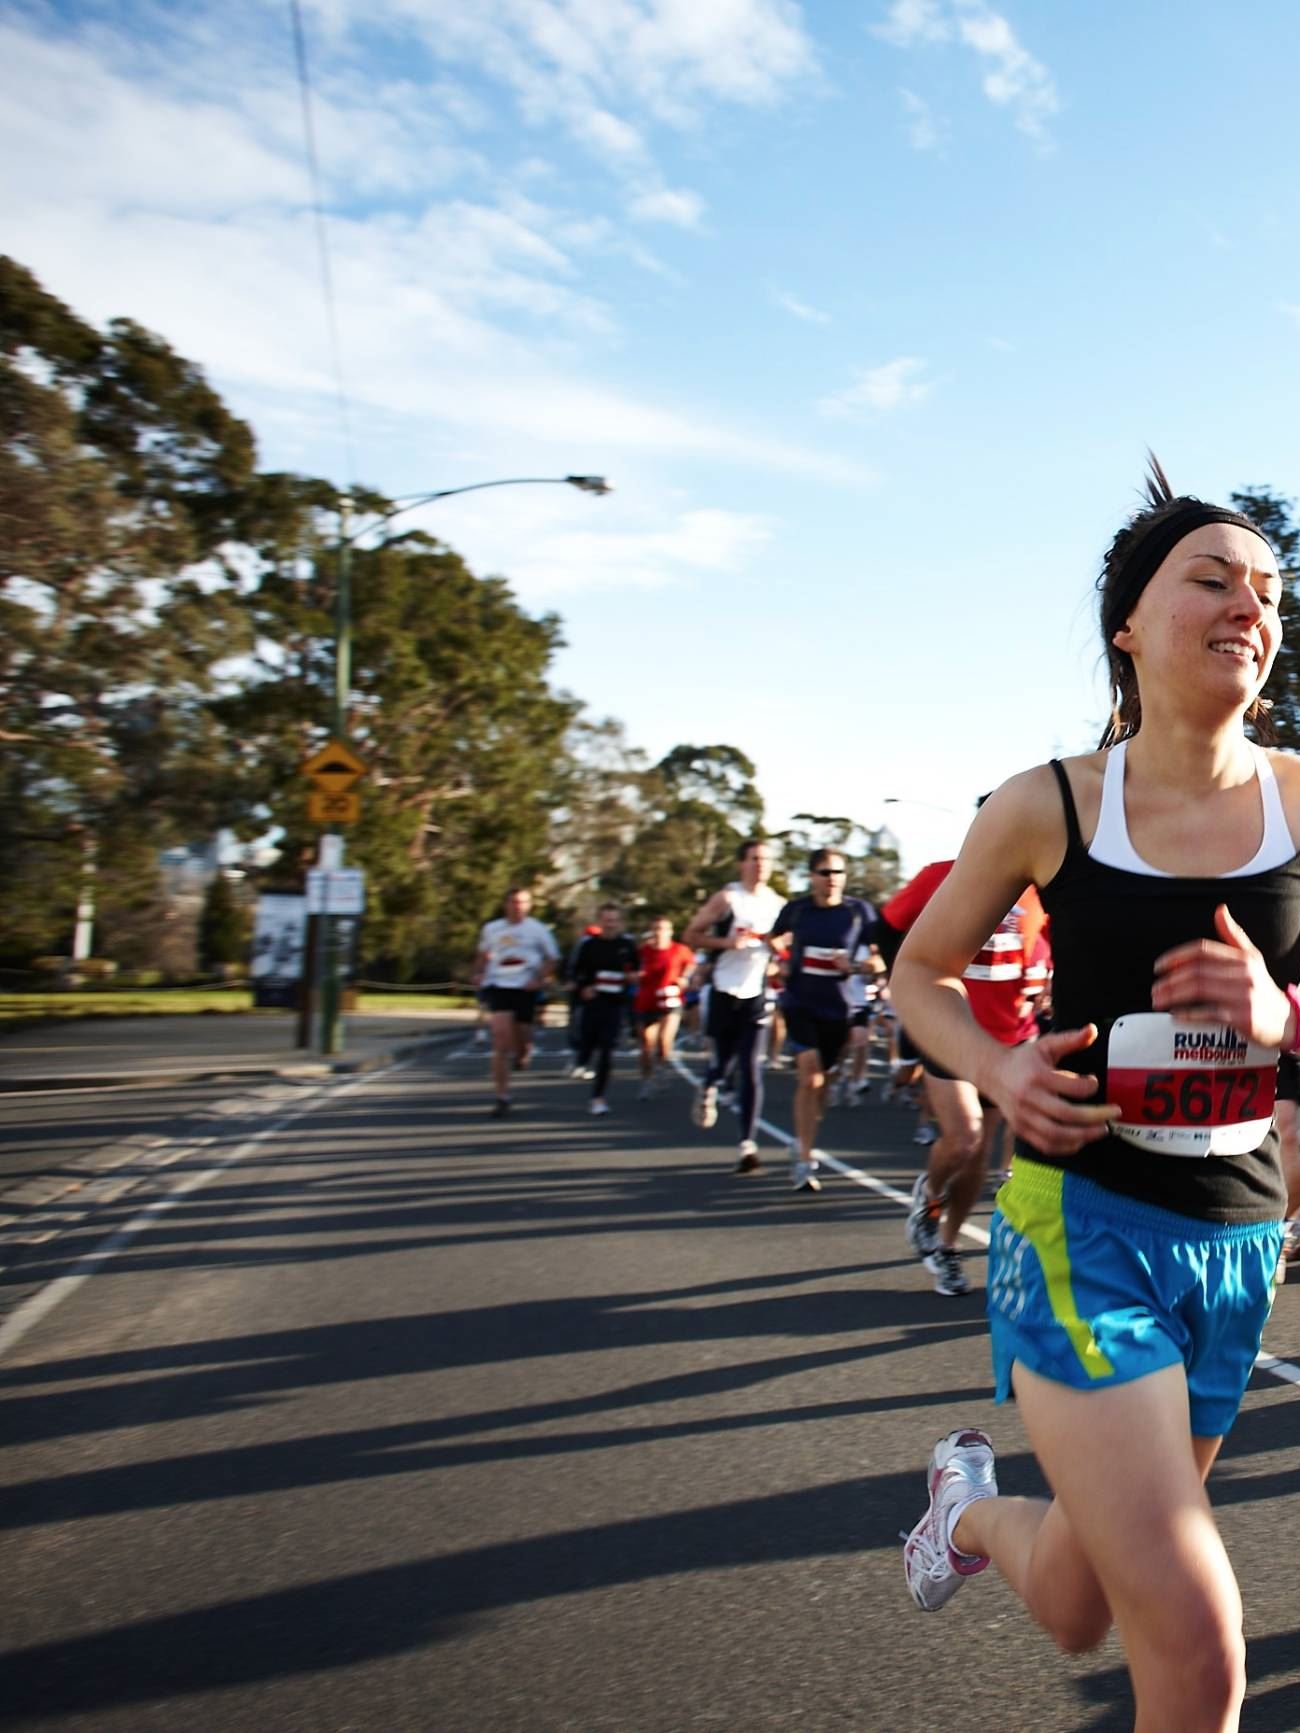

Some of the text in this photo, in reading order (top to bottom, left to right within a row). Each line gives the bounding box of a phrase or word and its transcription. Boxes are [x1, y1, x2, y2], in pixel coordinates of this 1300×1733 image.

[1174, 1032, 1215, 1048] RUN
[1174, 1047, 1248, 1061] melbourne
[1141, 1073, 1261, 1122] 5672
